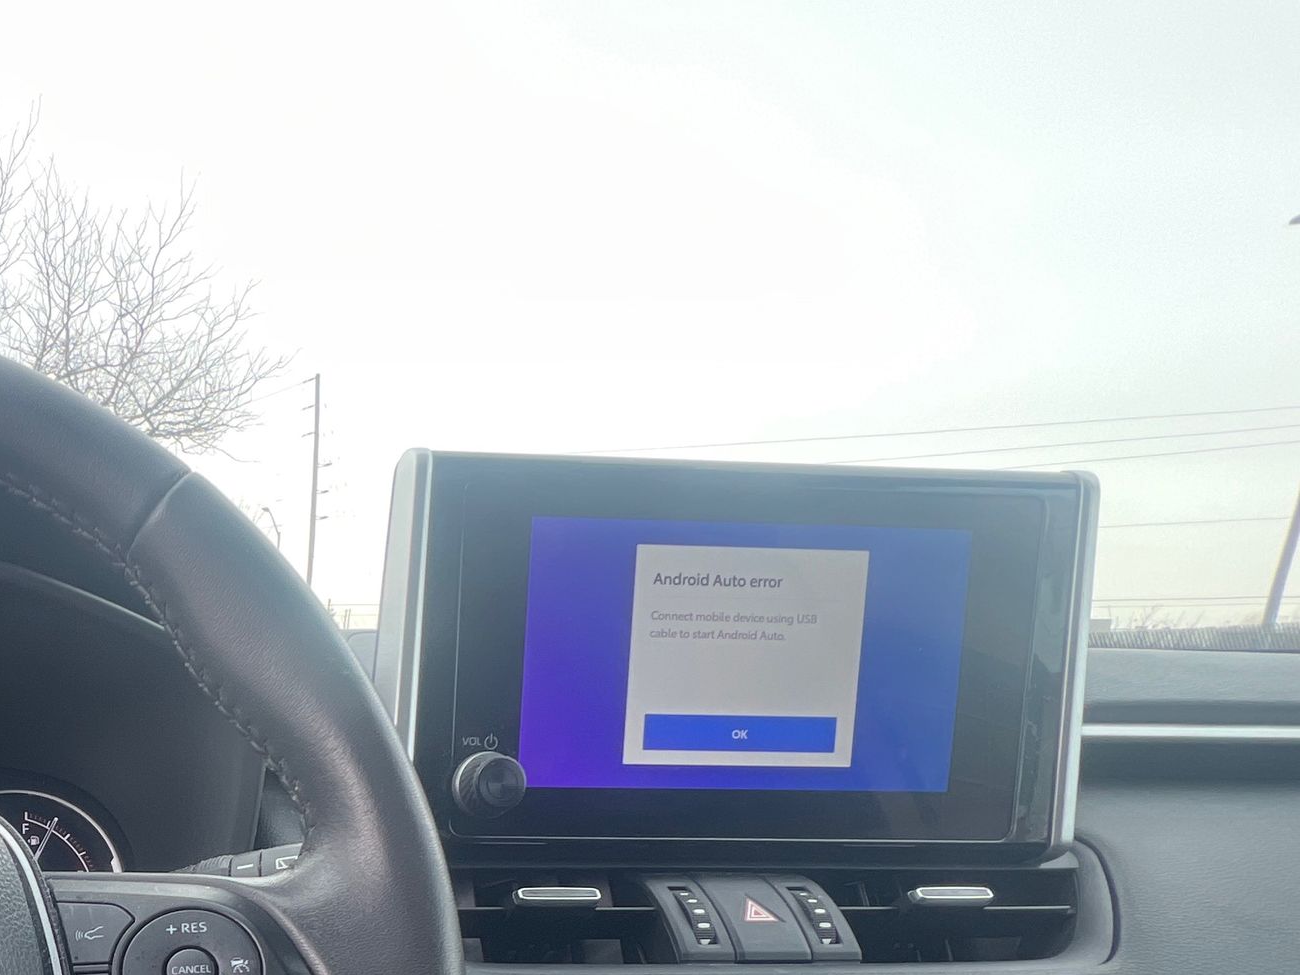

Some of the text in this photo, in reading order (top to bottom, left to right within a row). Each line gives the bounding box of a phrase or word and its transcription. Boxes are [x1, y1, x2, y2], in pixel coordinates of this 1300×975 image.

[653, 572, 783, 589] Android Auto error
[651, 610, 818, 626] Connect mobile device using USB
[649, 628, 786, 641] cable to start Android Auto.
[462, 736, 482, 746] VOL
[731, 729, 749, 740] OK
[21, 822, 30, 835] F
[181, 921, 208, 934] RES
[171, 963, 212, 975] CANCEL
